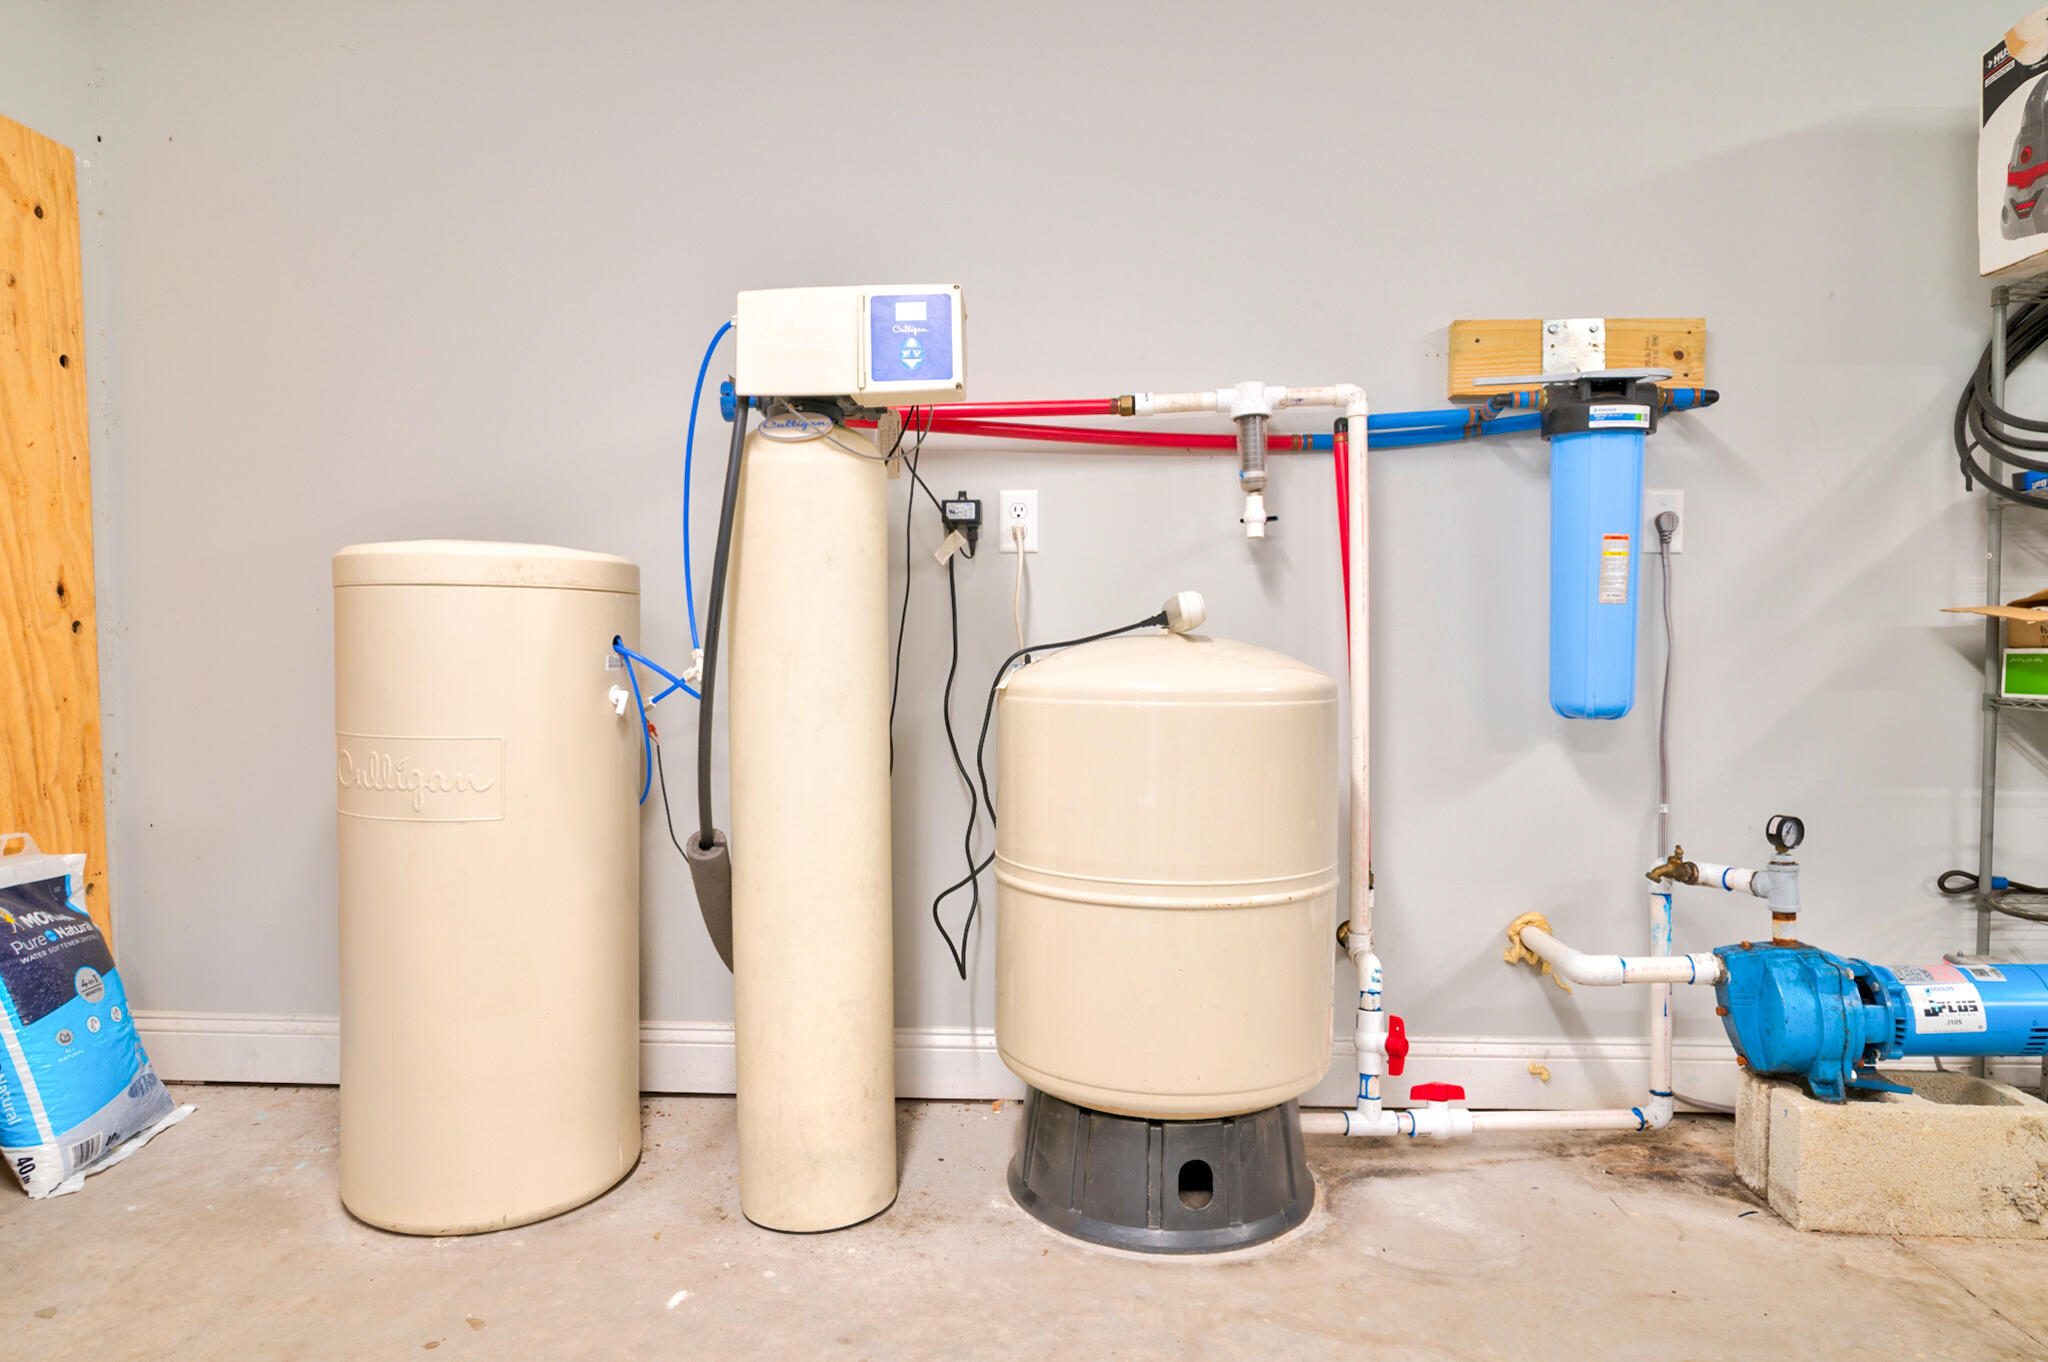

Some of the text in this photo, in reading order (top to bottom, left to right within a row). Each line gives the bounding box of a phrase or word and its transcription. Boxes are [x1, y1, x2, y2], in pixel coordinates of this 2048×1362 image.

[891, 324, 929, 337] Culligan
[337, 747, 495, 813] Culligan
[10, 934, 48, 956] Pure
[53, 920, 94, 940] Natural
[20, 949, 47, 965] WATER
[47, 938, 80, 955] SOFTENER
[16, 1156, 36, 1176] 40
